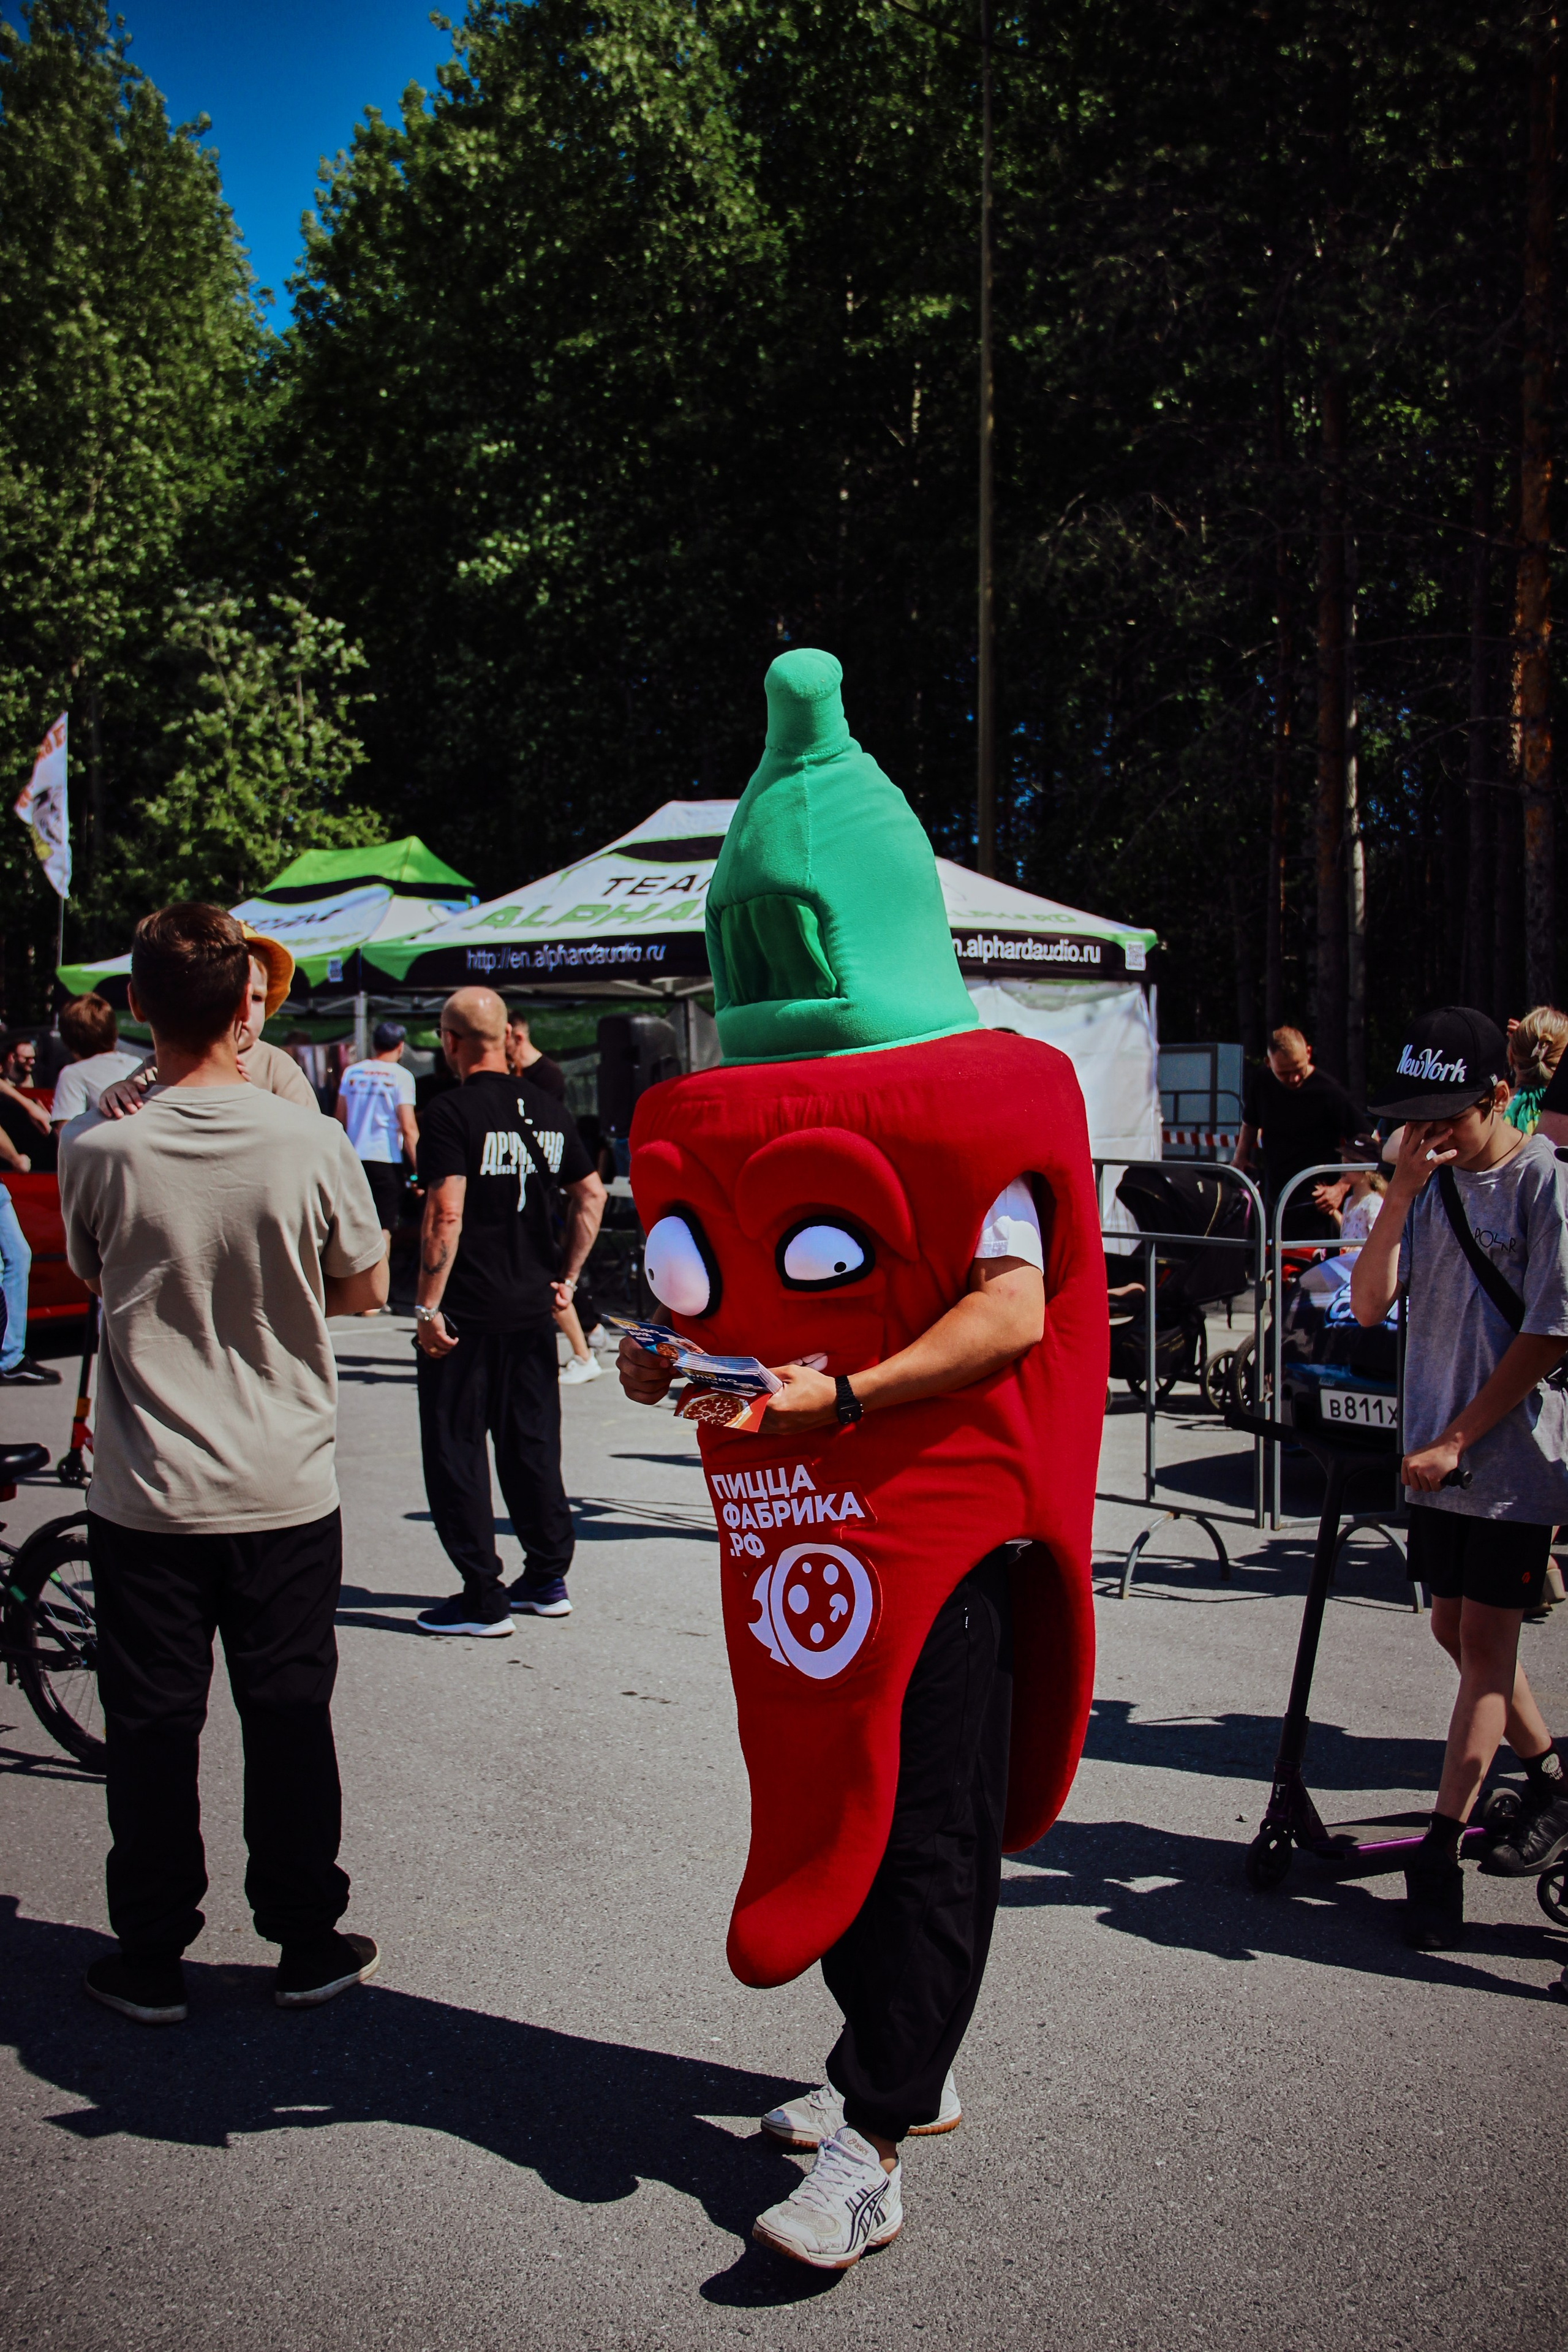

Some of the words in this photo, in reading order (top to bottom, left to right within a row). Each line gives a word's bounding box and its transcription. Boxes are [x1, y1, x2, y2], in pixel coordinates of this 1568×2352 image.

[461, 899, 706, 930] ALPHA
[466, 942, 667, 974] http://en.alphardaudio.ru
[480, 1131, 564, 1175] ДРУНА
[711, 1464, 816, 1500] ПИЦЦА
[723, 1491, 865, 1529] ФАБРИКА
[729, 1532, 765, 1558] .РФ
